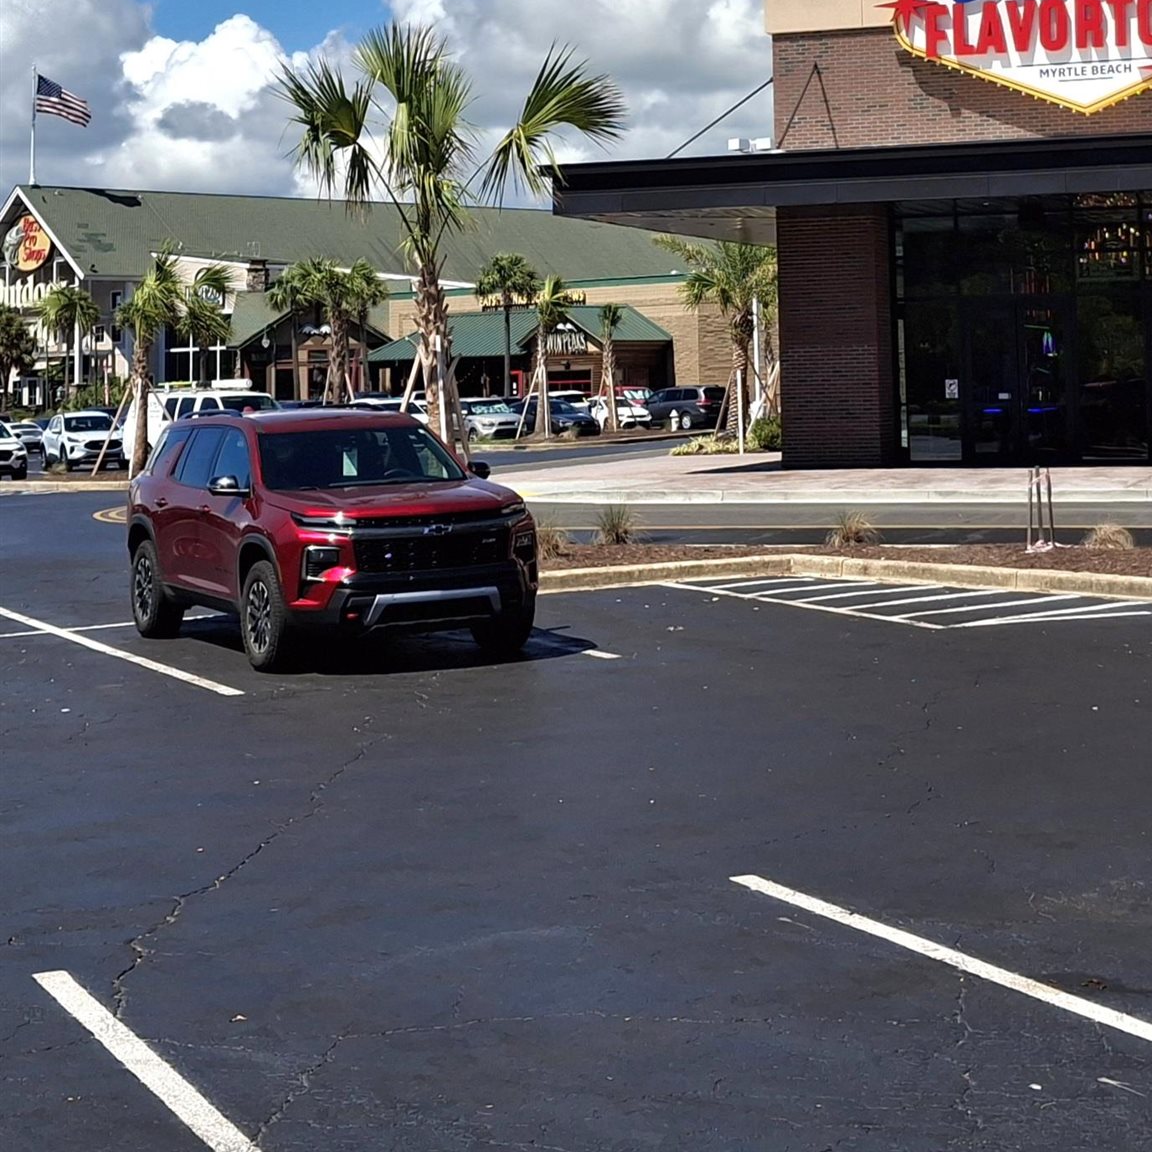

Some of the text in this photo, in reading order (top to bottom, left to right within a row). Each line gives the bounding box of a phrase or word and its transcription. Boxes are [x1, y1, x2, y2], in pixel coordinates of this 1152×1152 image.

[1040, 63, 1132, 79] MYRTLE BEACH
[0, 274, 68, 308] utdo
